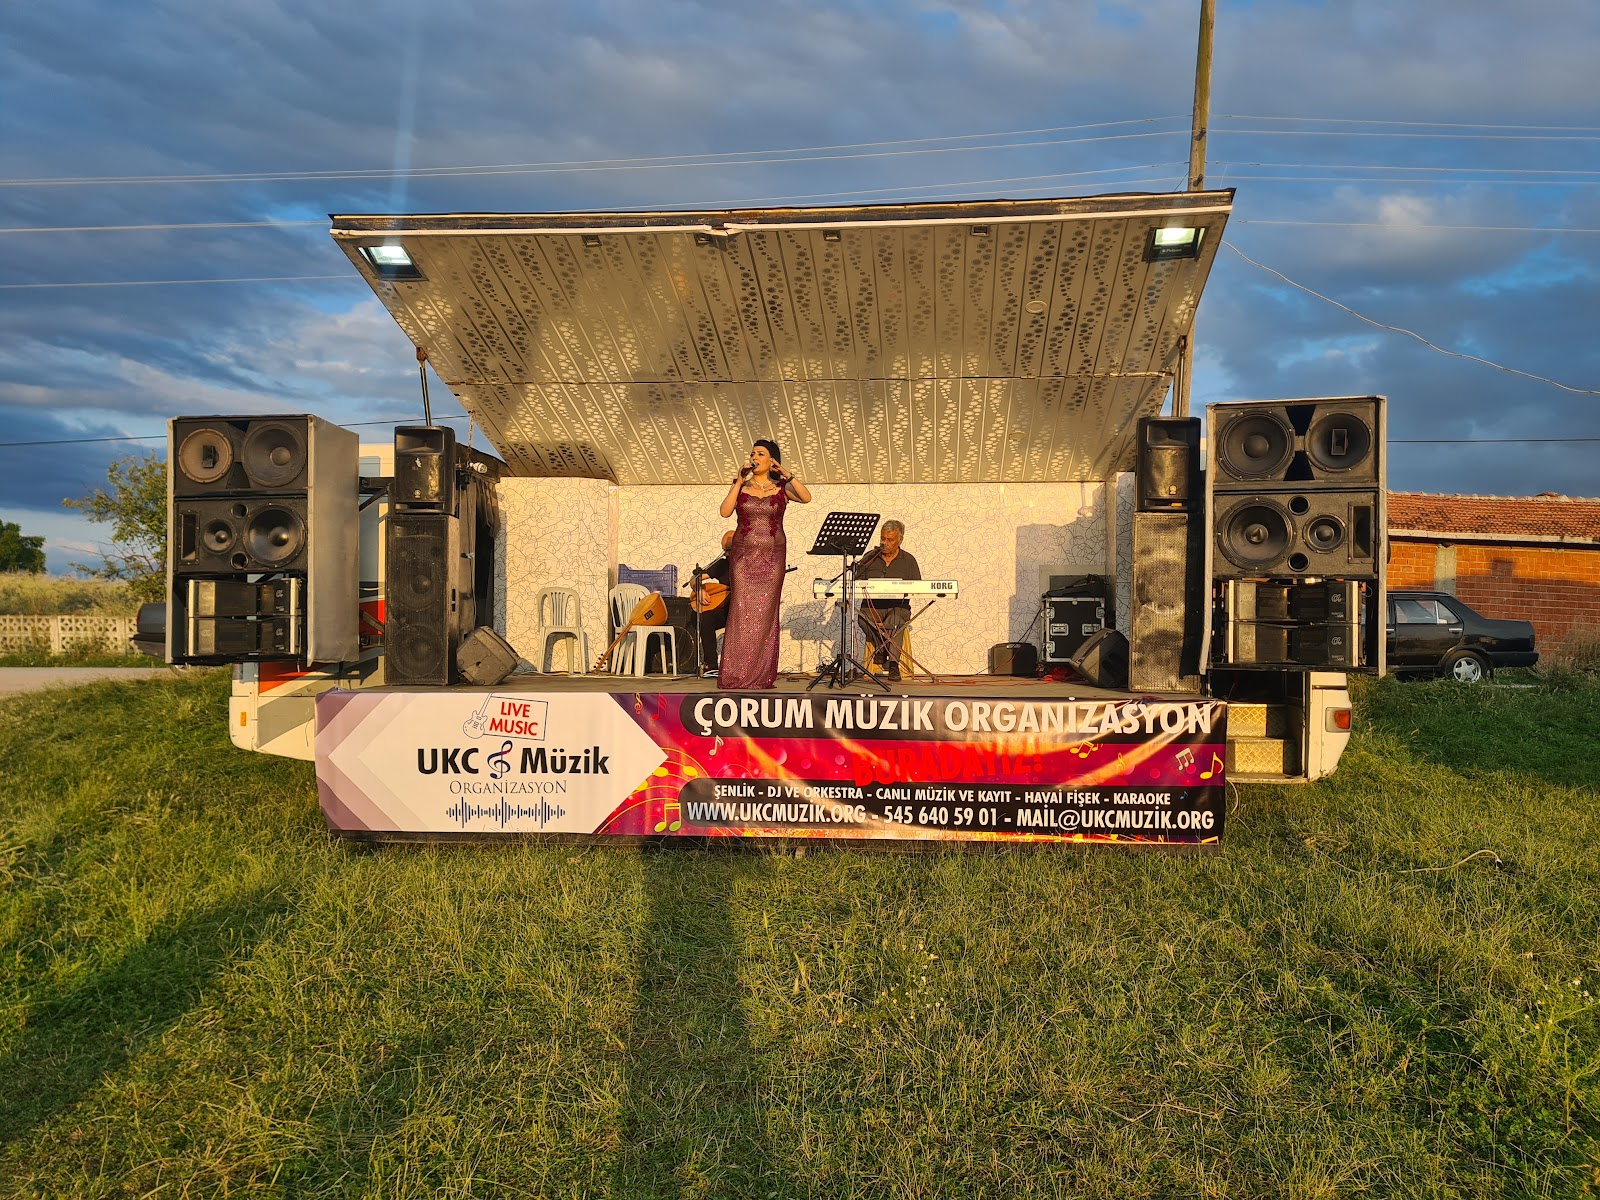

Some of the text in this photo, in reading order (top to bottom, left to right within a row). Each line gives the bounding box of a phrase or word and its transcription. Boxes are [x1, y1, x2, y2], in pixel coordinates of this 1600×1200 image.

[930, 582, 954, 590] KORG
[500, 701, 531, 719] LIVE
[693, 693, 1212, 736] ÇORUM MÜZİK ORGANİZASYON
[489, 718, 538, 737] MUSIC
[417, 746, 610, 775] UKC Müzik
[449, 780, 568, 795] ORGANİZASYON
[714, 782, 755, 800] ŞENLİK
[767, 786, 782, 798] DJ
[784, 787, 799, 798] VE
[803, 787, 864, 800] ORKESTRA
[876, 787, 911, 801] CANLI
[915, 786, 956, 802] MÜZİK
[958, 790, 974, 802] VE
[978, 790, 1012, 803] KAYIT
[1024, 789, 1063, 804] HAVAİ
[1067, 789, 1100, 808] FİŞEK
[1113, 793, 1171, 806] KARAOKE
[883, 806, 913, 824] 545
[918, 807, 949, 825] 640
[953, 808, 973, 826] 59
[978, 808, 997, 826] 01
